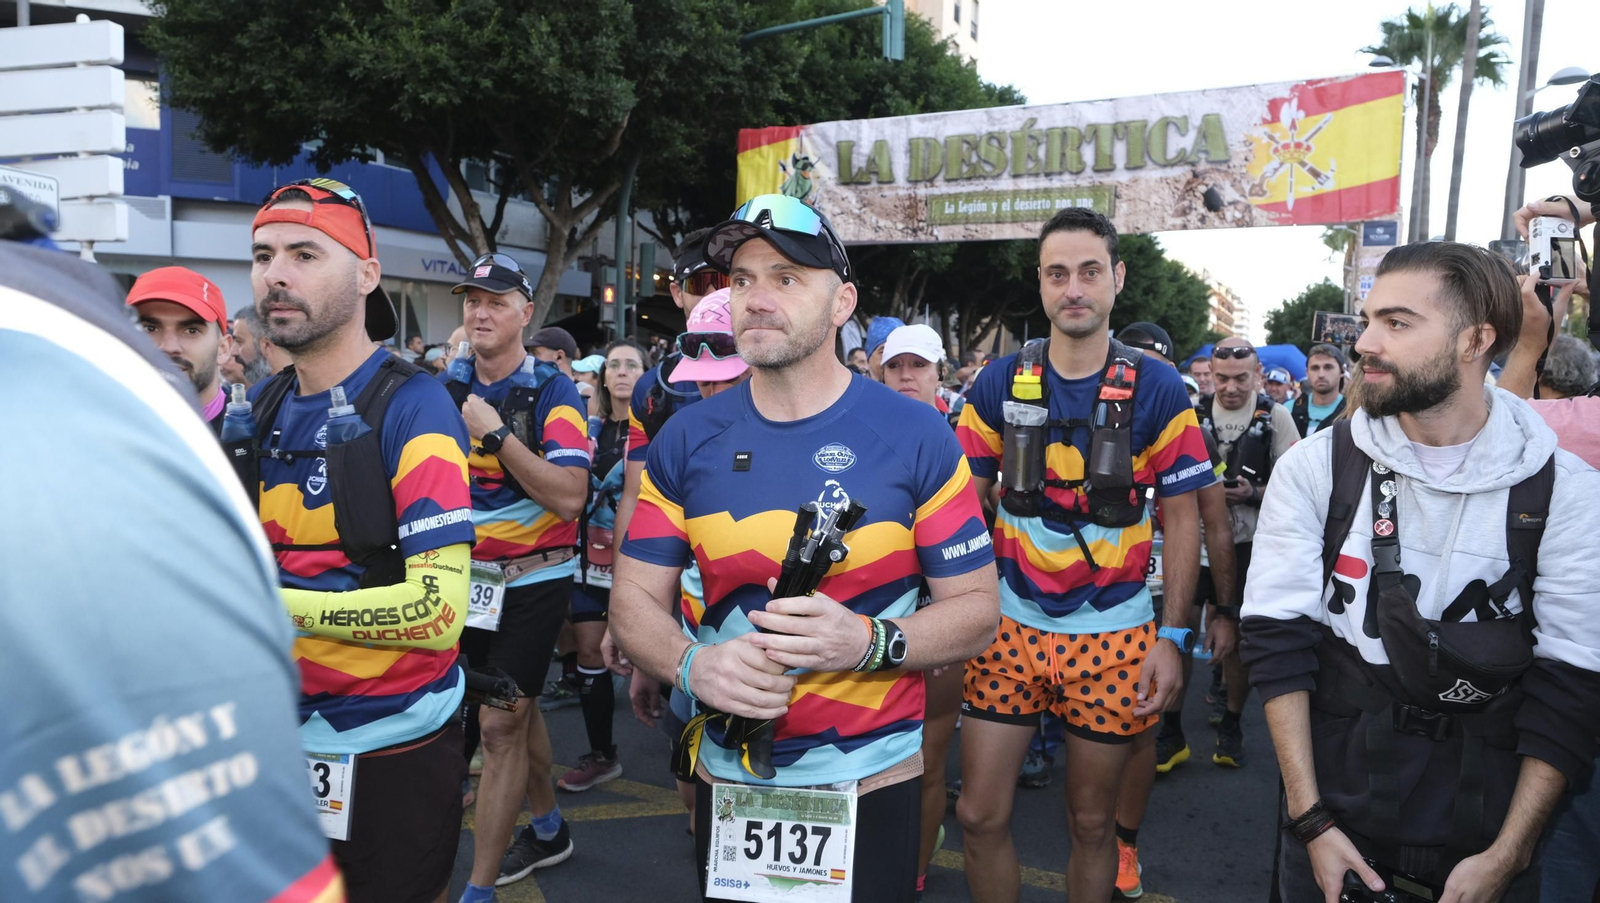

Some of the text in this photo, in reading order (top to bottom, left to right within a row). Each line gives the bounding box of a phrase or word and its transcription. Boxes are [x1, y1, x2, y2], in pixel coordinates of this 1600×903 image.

[836, 113, 1231, 185] LA DESÉRTICA
[1, 174, 54, 192] AVENIDA
[944, 196, 1094, 215] La Legión y el desierto nos une
[320, 607, 399, 627] HÉROES
[353, 602, 456, 641] DUCHENNE
[743, 820, 831, 867] 5137
[767, 864, 790, 873] HUEVOS
[799, 867, 828, 877] JAMONES
[713, 877, 742, 889] asisa
